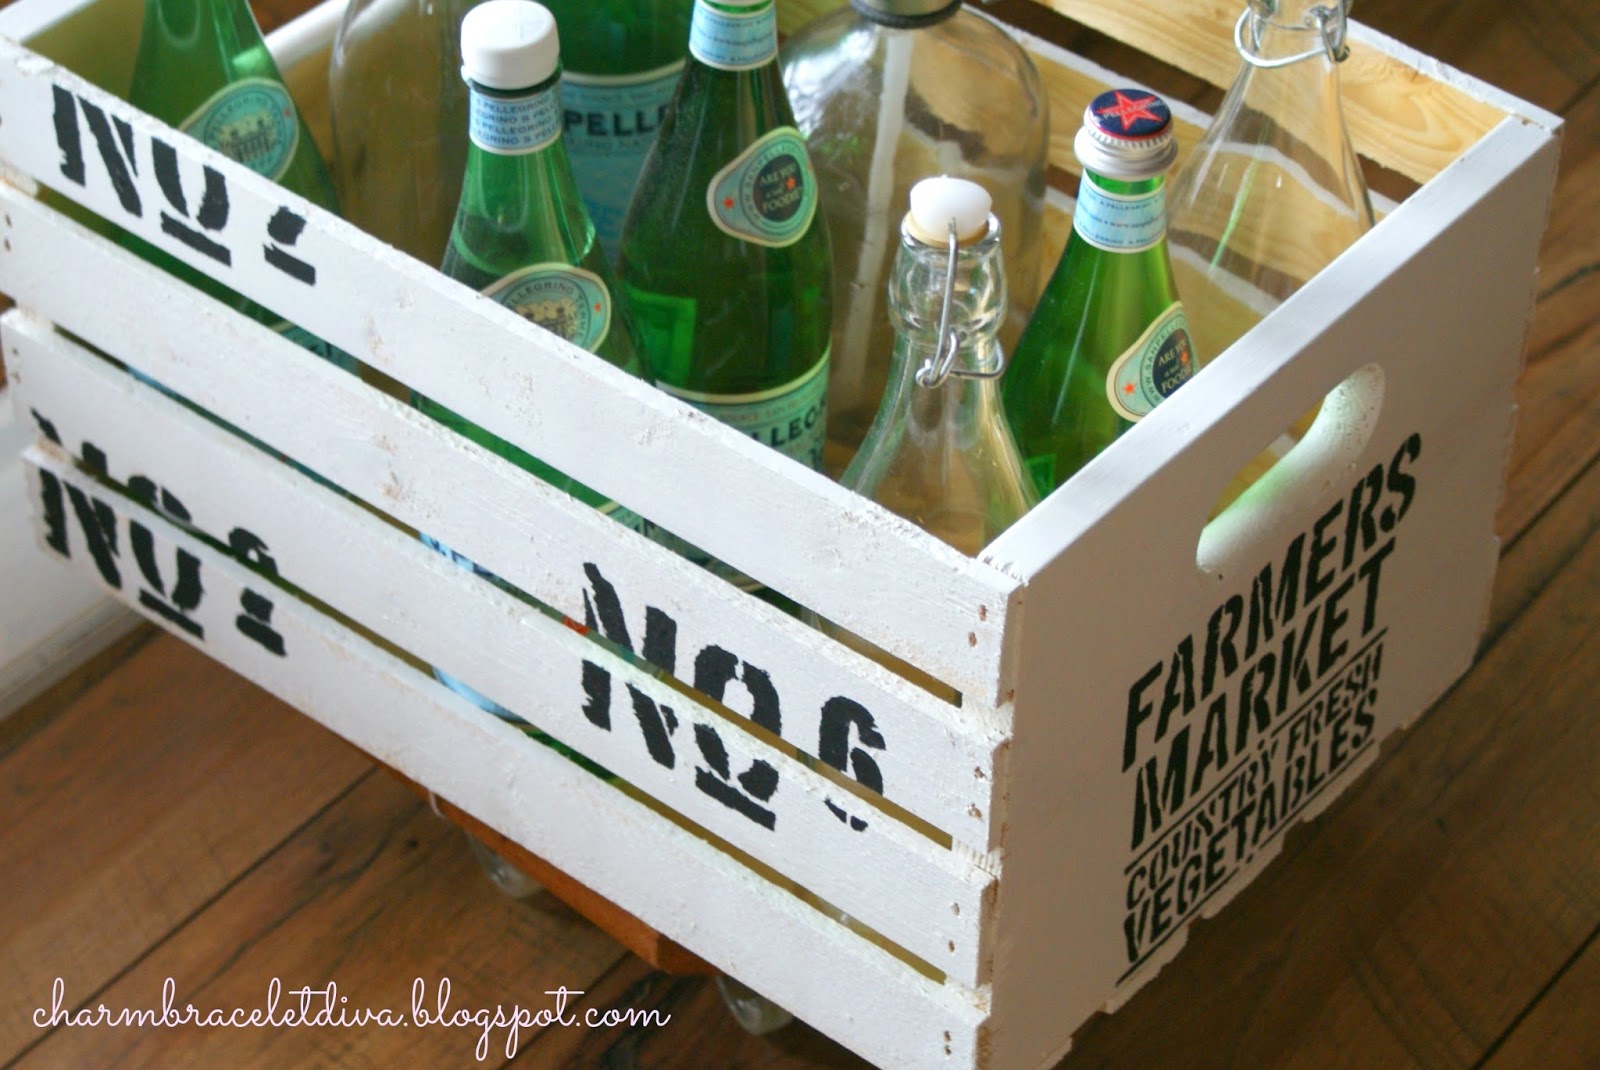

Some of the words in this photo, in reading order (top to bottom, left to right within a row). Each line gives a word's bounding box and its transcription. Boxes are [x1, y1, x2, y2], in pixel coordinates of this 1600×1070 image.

[1122, 432, 1422, 774] FARMERS
[1131, 536, 1396, 851] MARKET
[1123, 688, 1378, 963] VEGETABLES
[1126, 739, 1279, 911] COUNTRY
[1285, 642, 1384, 764] FRESH
